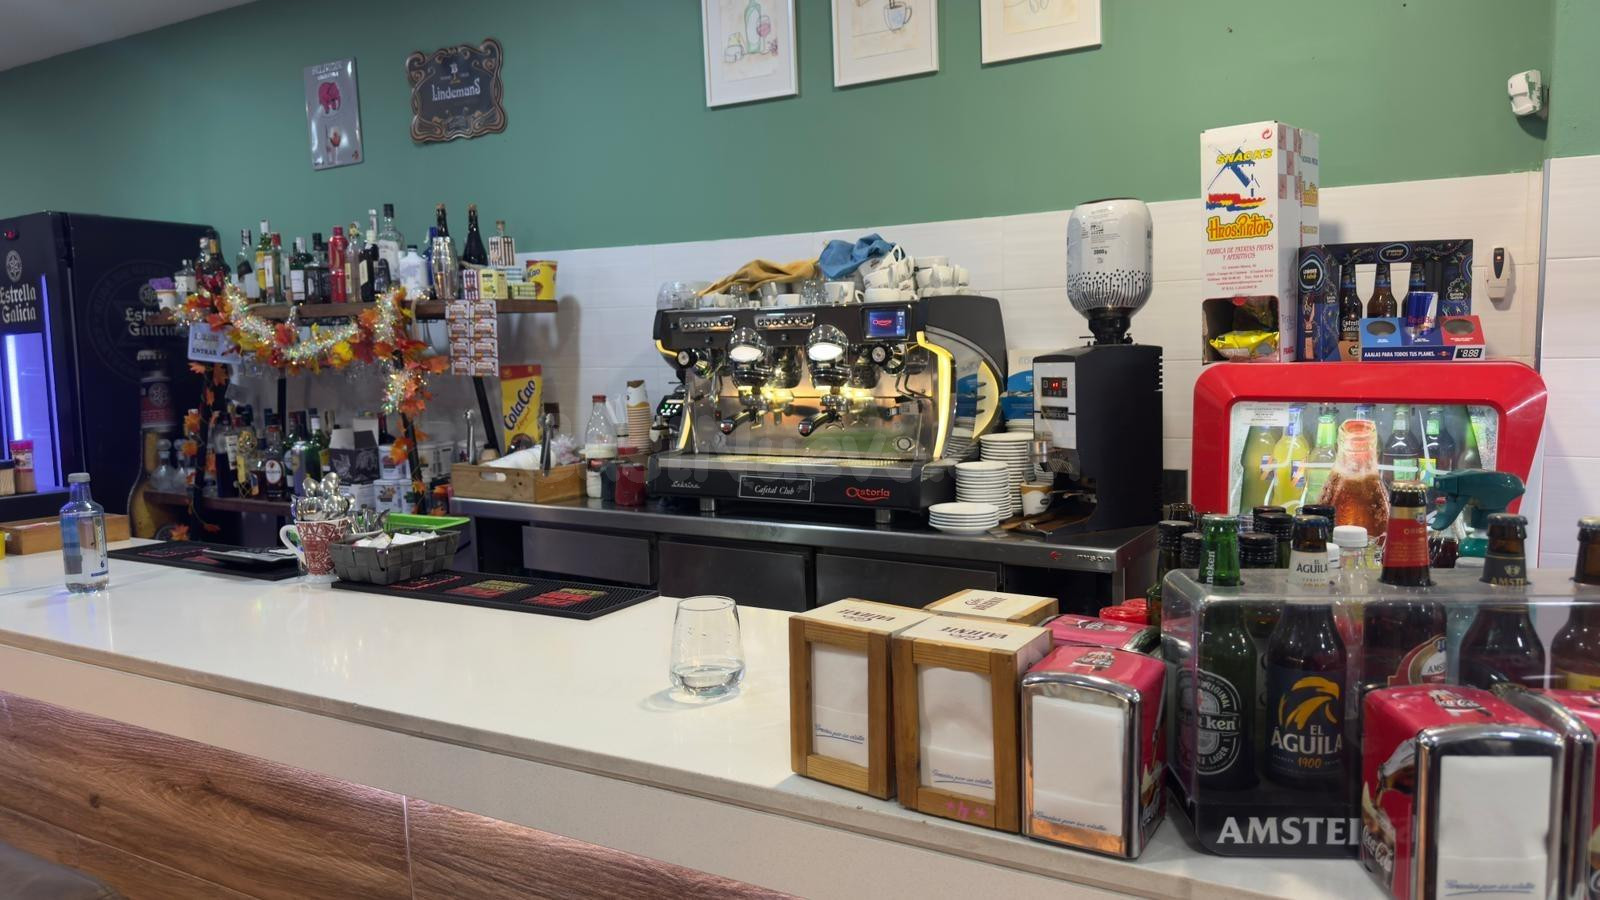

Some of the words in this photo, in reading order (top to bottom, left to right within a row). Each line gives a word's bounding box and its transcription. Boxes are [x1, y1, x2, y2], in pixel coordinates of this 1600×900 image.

[1216, 148, 1273, 165] SNACKS
[0, 283, 36, 304] Estrella
[2, 302, 36, 324] Galicia
[504, 380, 536, 430] ColaCao
[779, 485, 795, 496] Club
[1205, 550, 1216, 584] neken
[1310, 724, 1325, 736] EL
[1296, 756, 1322, 769] 1900
